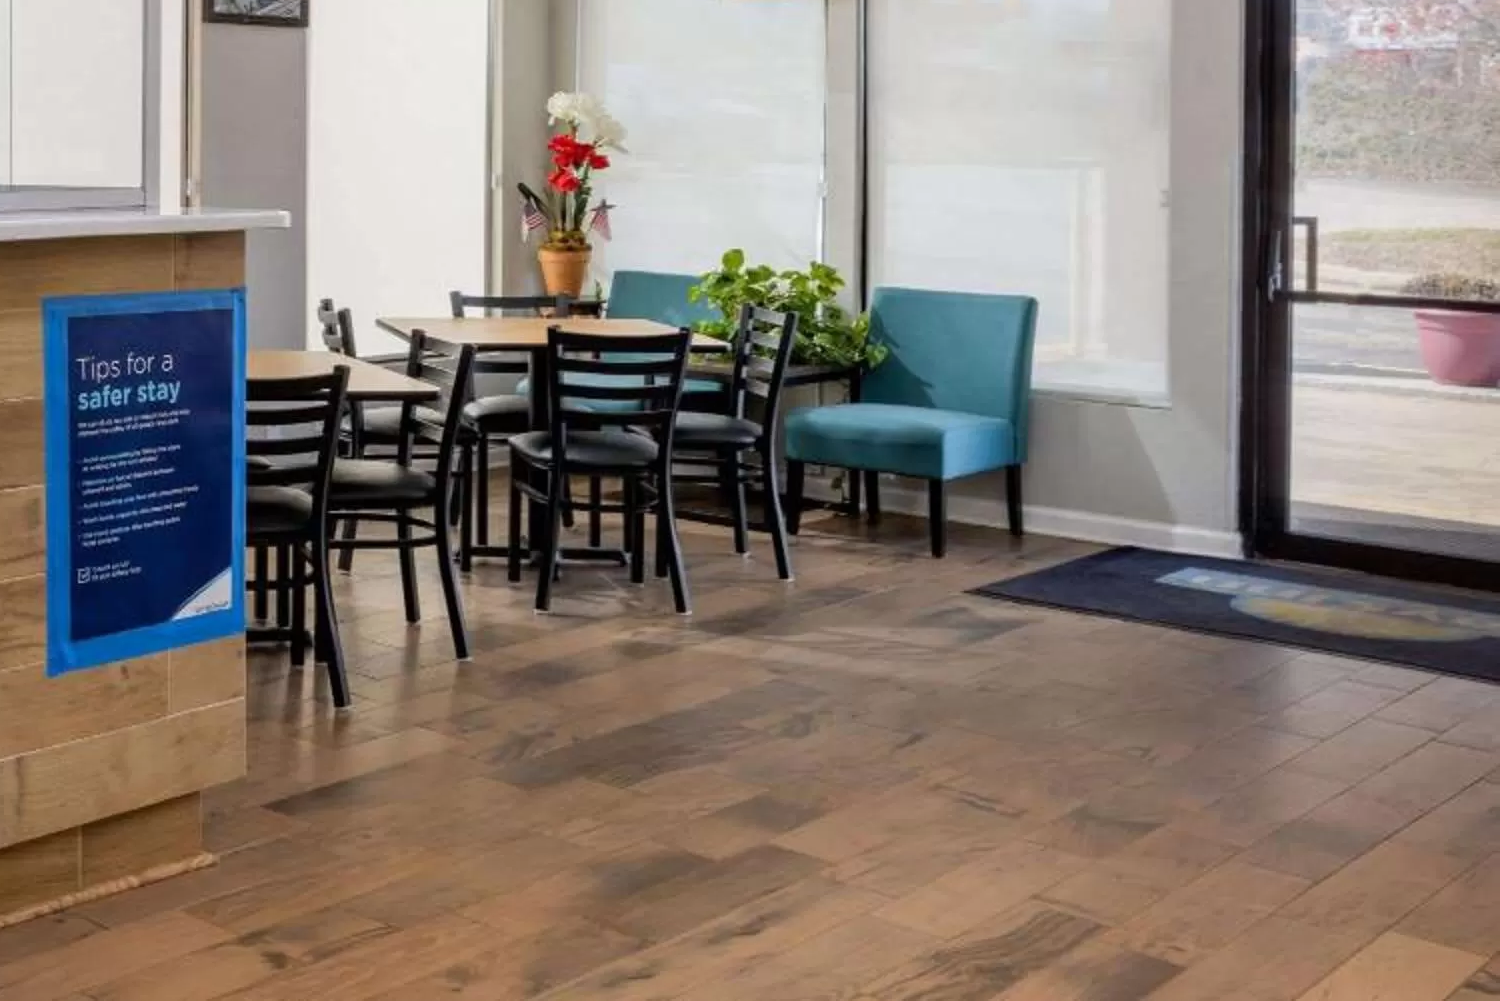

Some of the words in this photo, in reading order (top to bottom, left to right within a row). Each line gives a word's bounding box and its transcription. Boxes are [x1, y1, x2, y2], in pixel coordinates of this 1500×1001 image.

[76, 355, 121, 384] Tips
[127, 351, 155, 375] for
[161, 354, 174, 373] a
[77, 385, 131, 411] safer
[137, 380, 181, 404] stay
